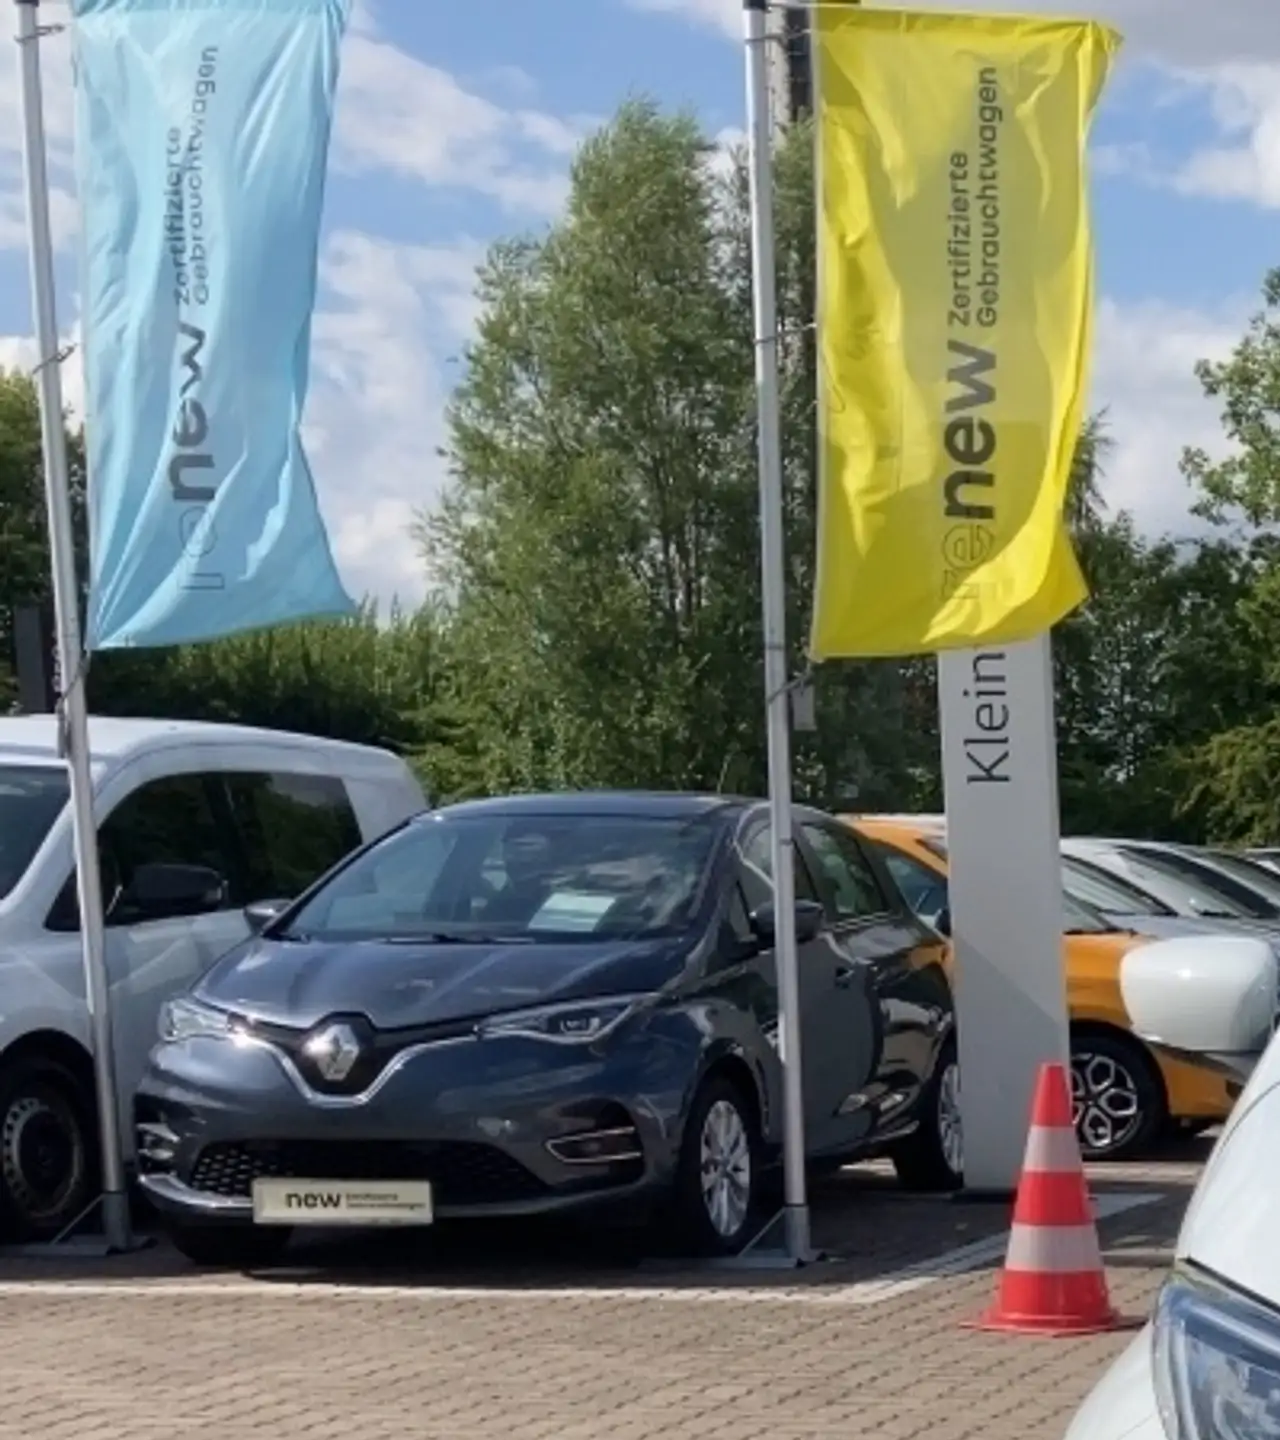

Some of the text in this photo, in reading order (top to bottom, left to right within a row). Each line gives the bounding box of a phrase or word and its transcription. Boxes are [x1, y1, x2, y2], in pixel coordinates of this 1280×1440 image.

[948, 151, 971, 327] Zertifizierte
[975, 66, 1003, 328] Gebrauchtwagen
[963, 652, 1011, 785] Klein
